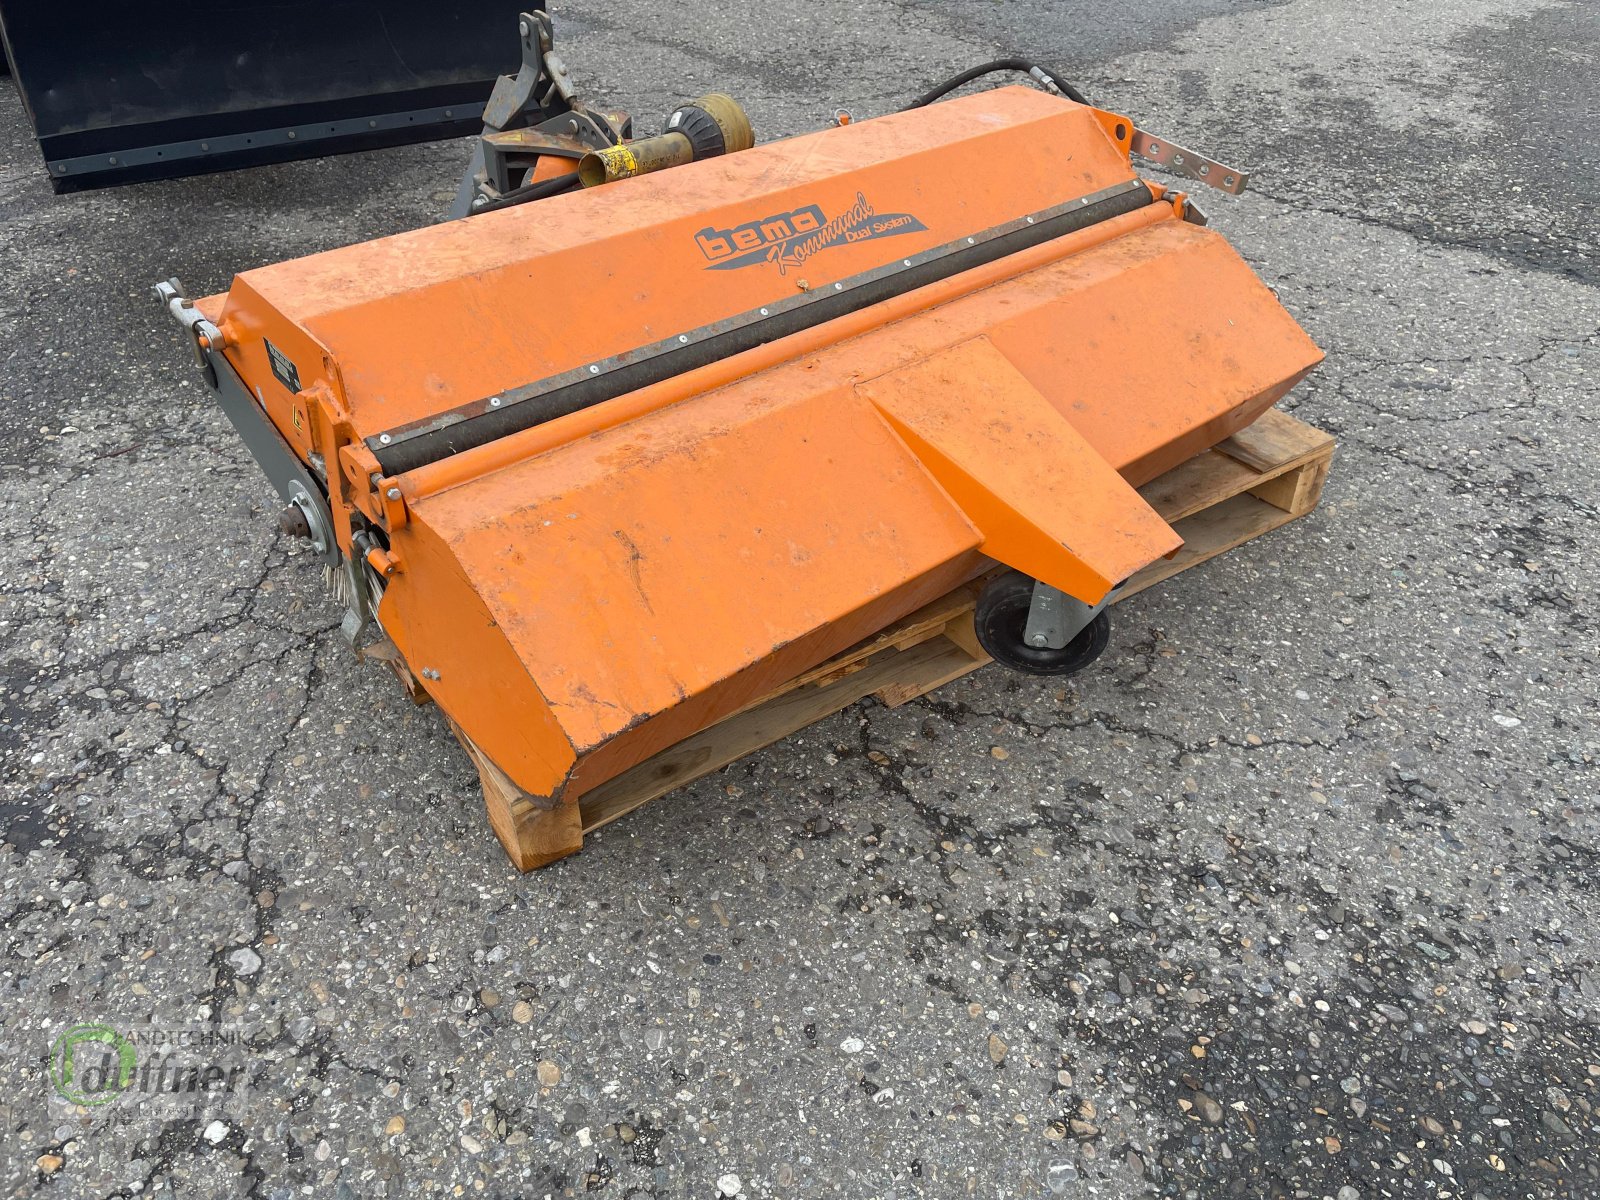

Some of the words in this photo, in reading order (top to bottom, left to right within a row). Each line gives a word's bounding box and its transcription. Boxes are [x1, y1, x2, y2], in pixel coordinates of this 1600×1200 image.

[695, 208, 823, 260] bema
[765, 192, 874, 275] Kommunal
[844, 226, 872, 243] Dual
[873, 214, 912, 232] System
